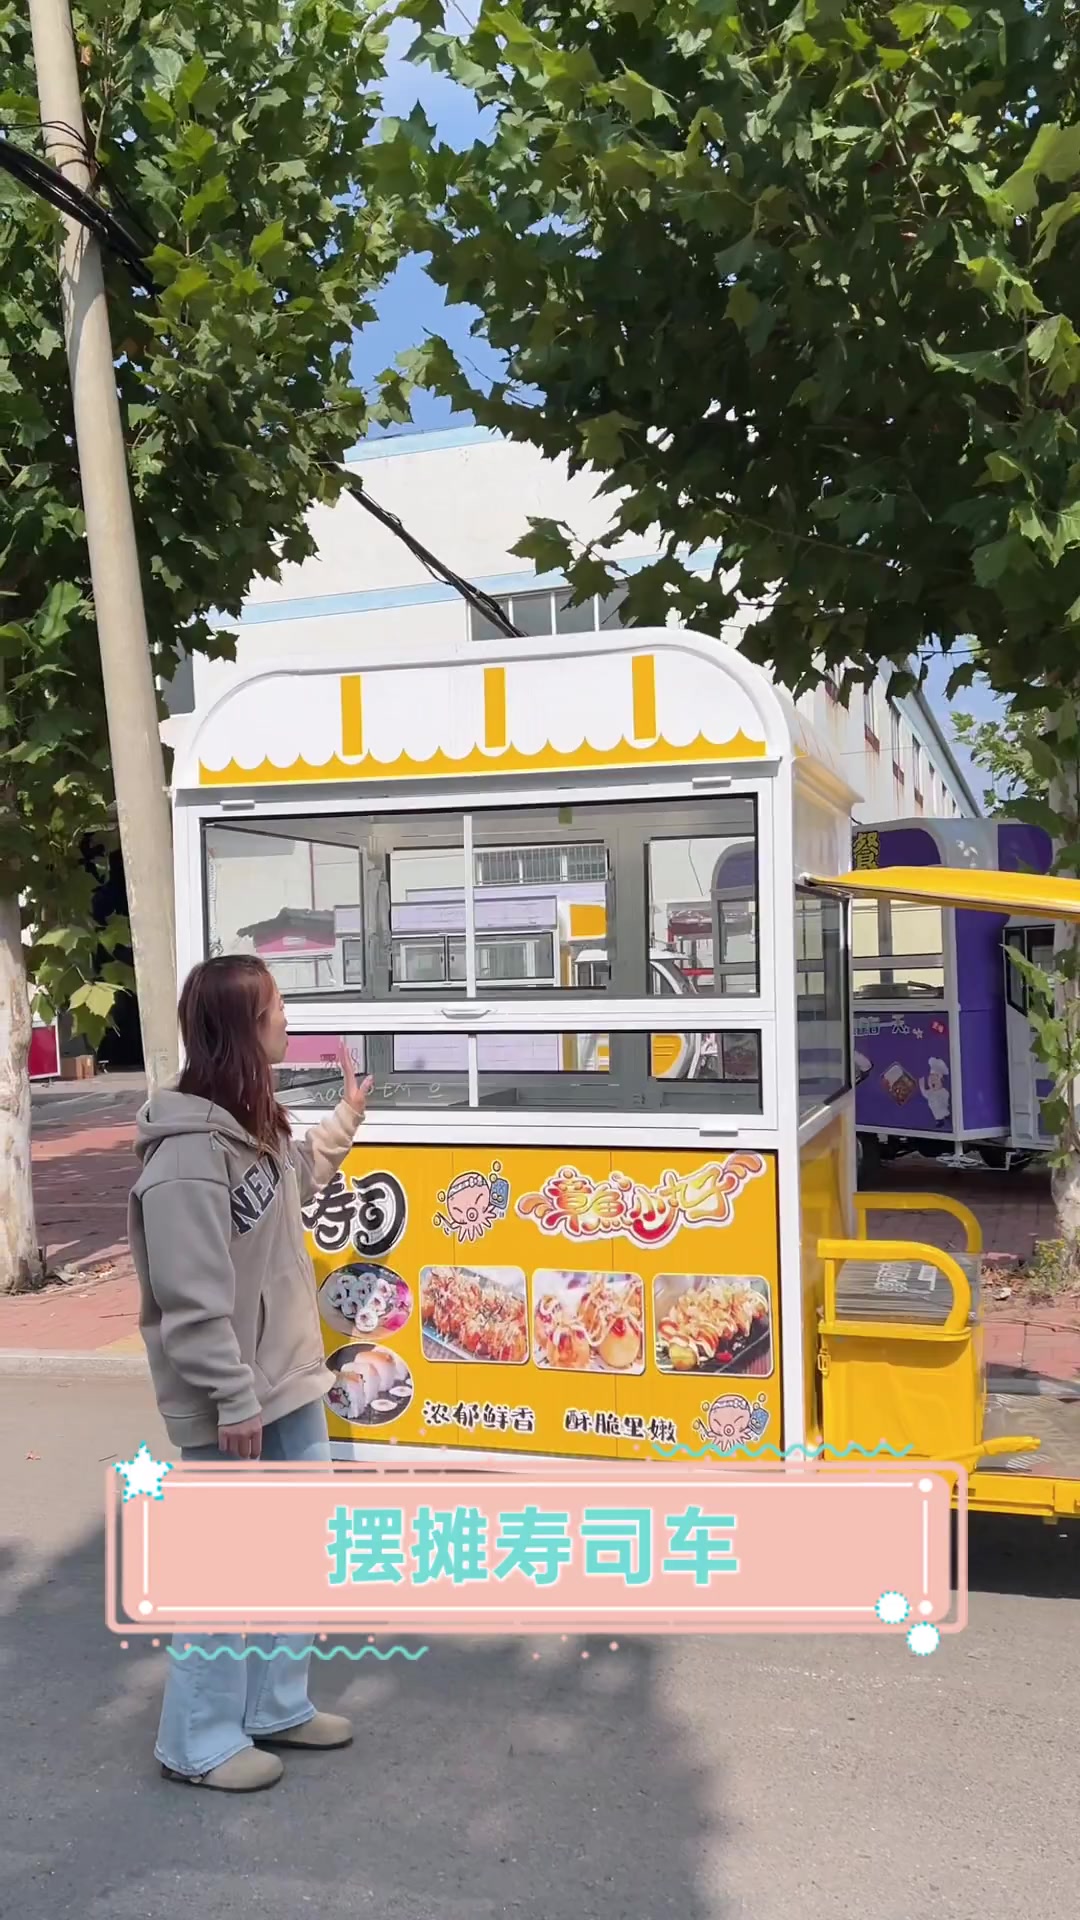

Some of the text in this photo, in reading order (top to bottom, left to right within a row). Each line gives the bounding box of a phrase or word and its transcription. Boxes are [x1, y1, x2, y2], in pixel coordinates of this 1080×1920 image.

[540, 1163, 742, 1246] 章鱼小丸子
[421, 1400, 678, 1444] 浓郁鲜香 酥脆里嫩
